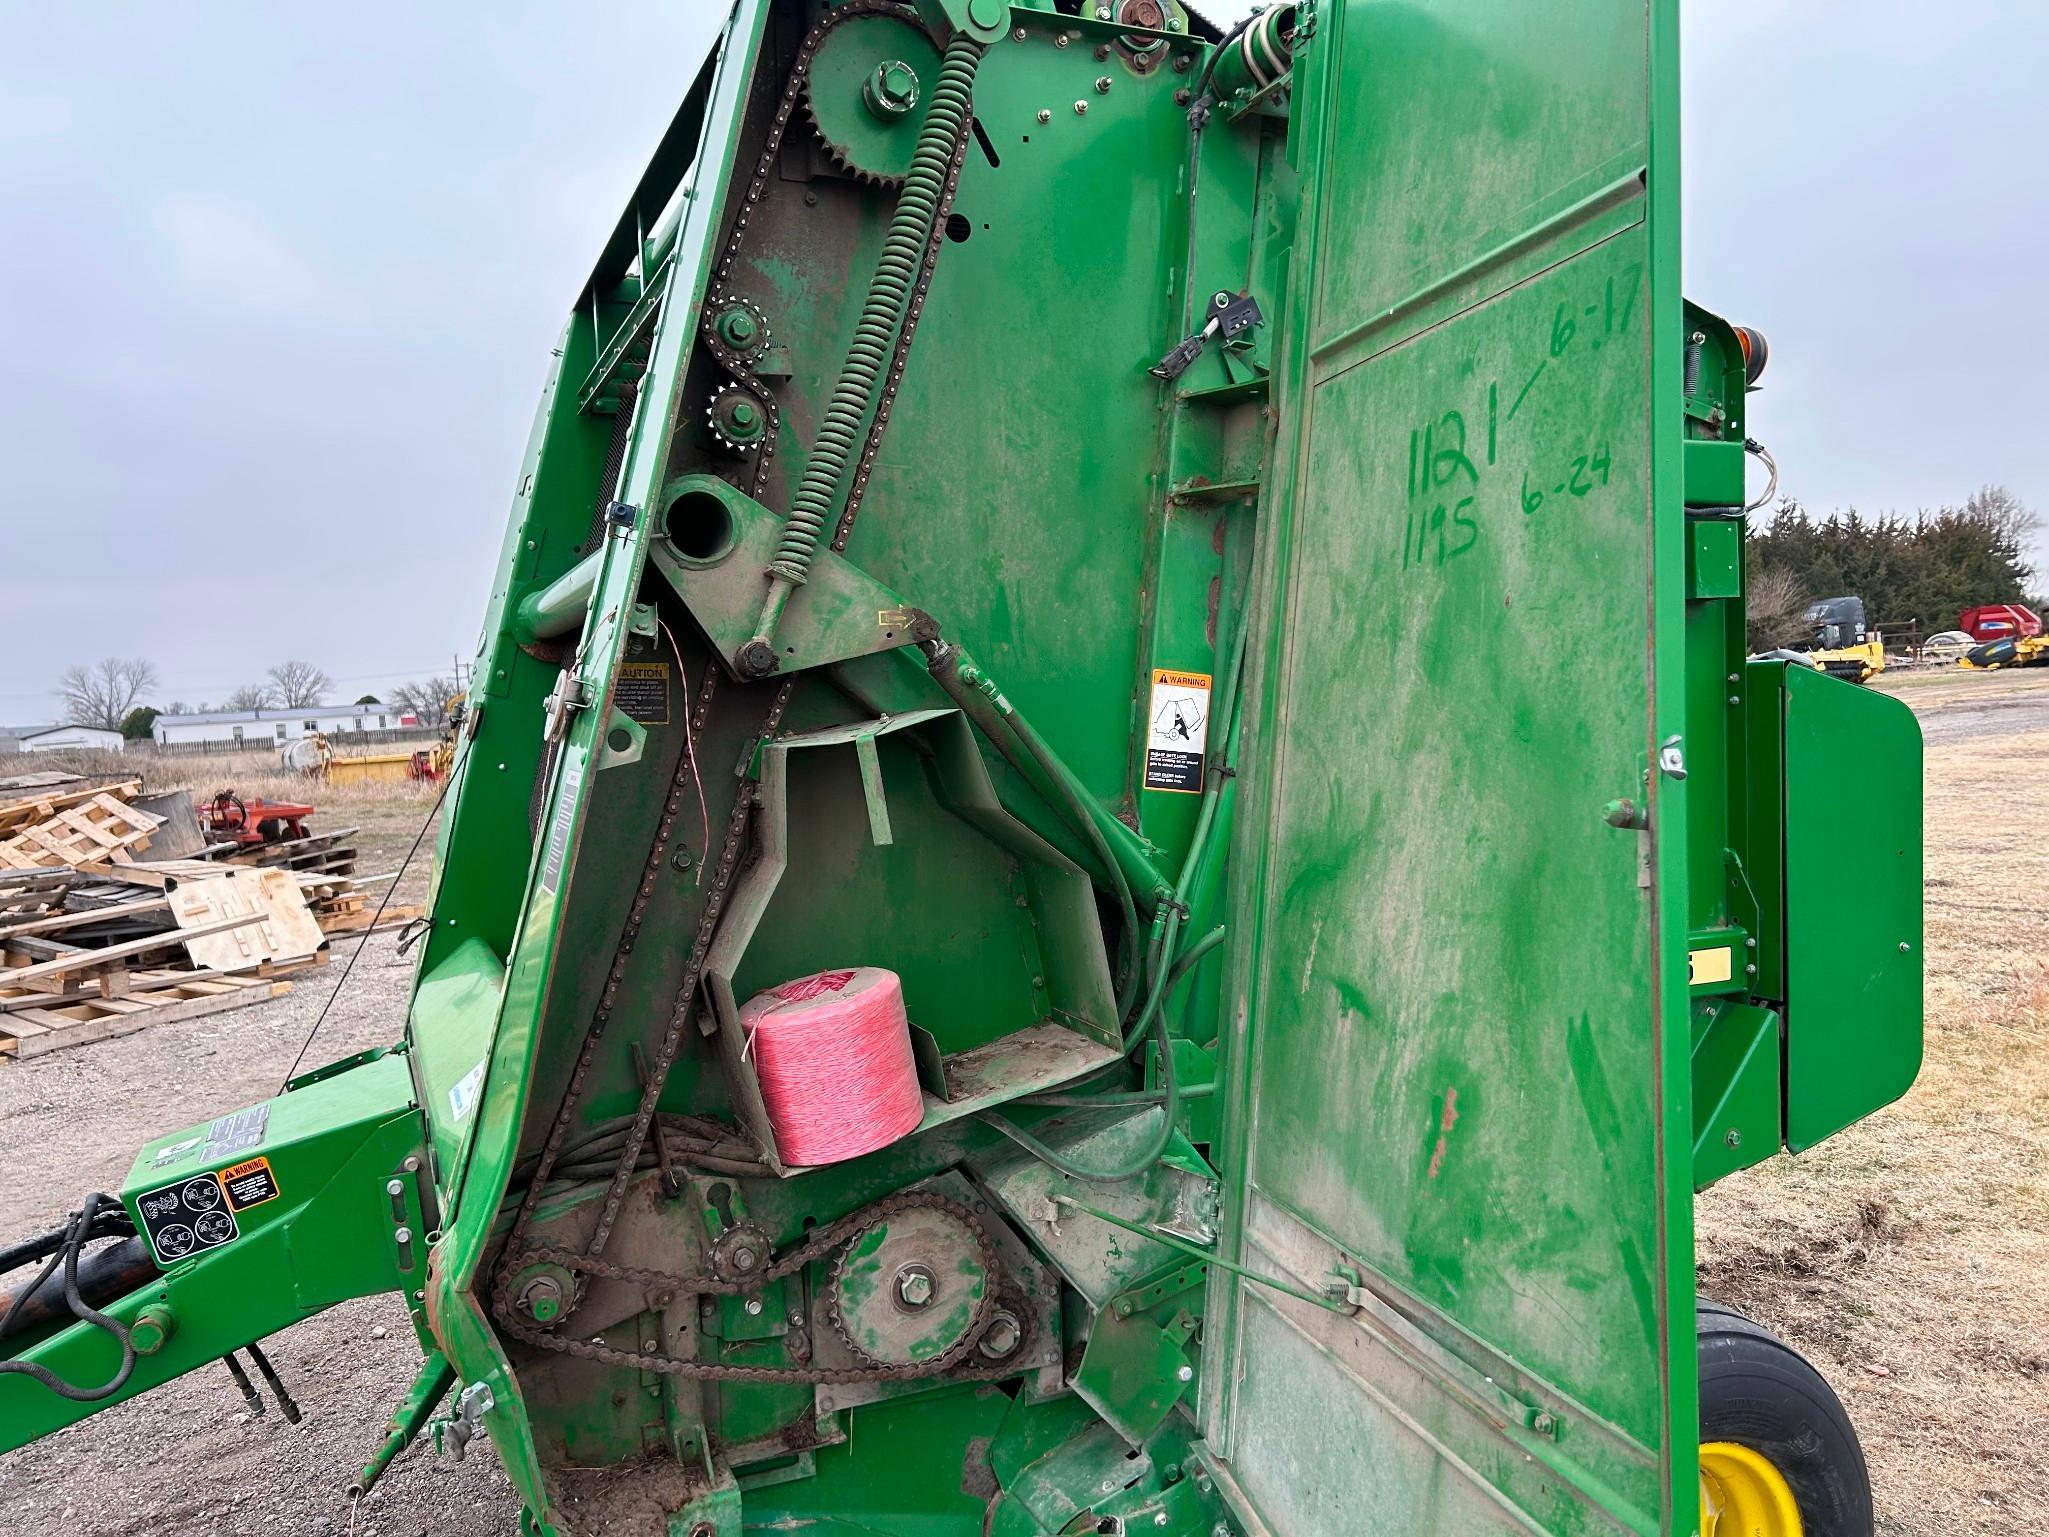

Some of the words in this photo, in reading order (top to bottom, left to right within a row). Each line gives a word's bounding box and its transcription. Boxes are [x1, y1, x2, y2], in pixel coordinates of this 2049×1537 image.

[621, 669, 663, 678] AUTION
[1169, 675, 1206, 687] WARNING
[233, 1158, 264, 1177] WARNING
